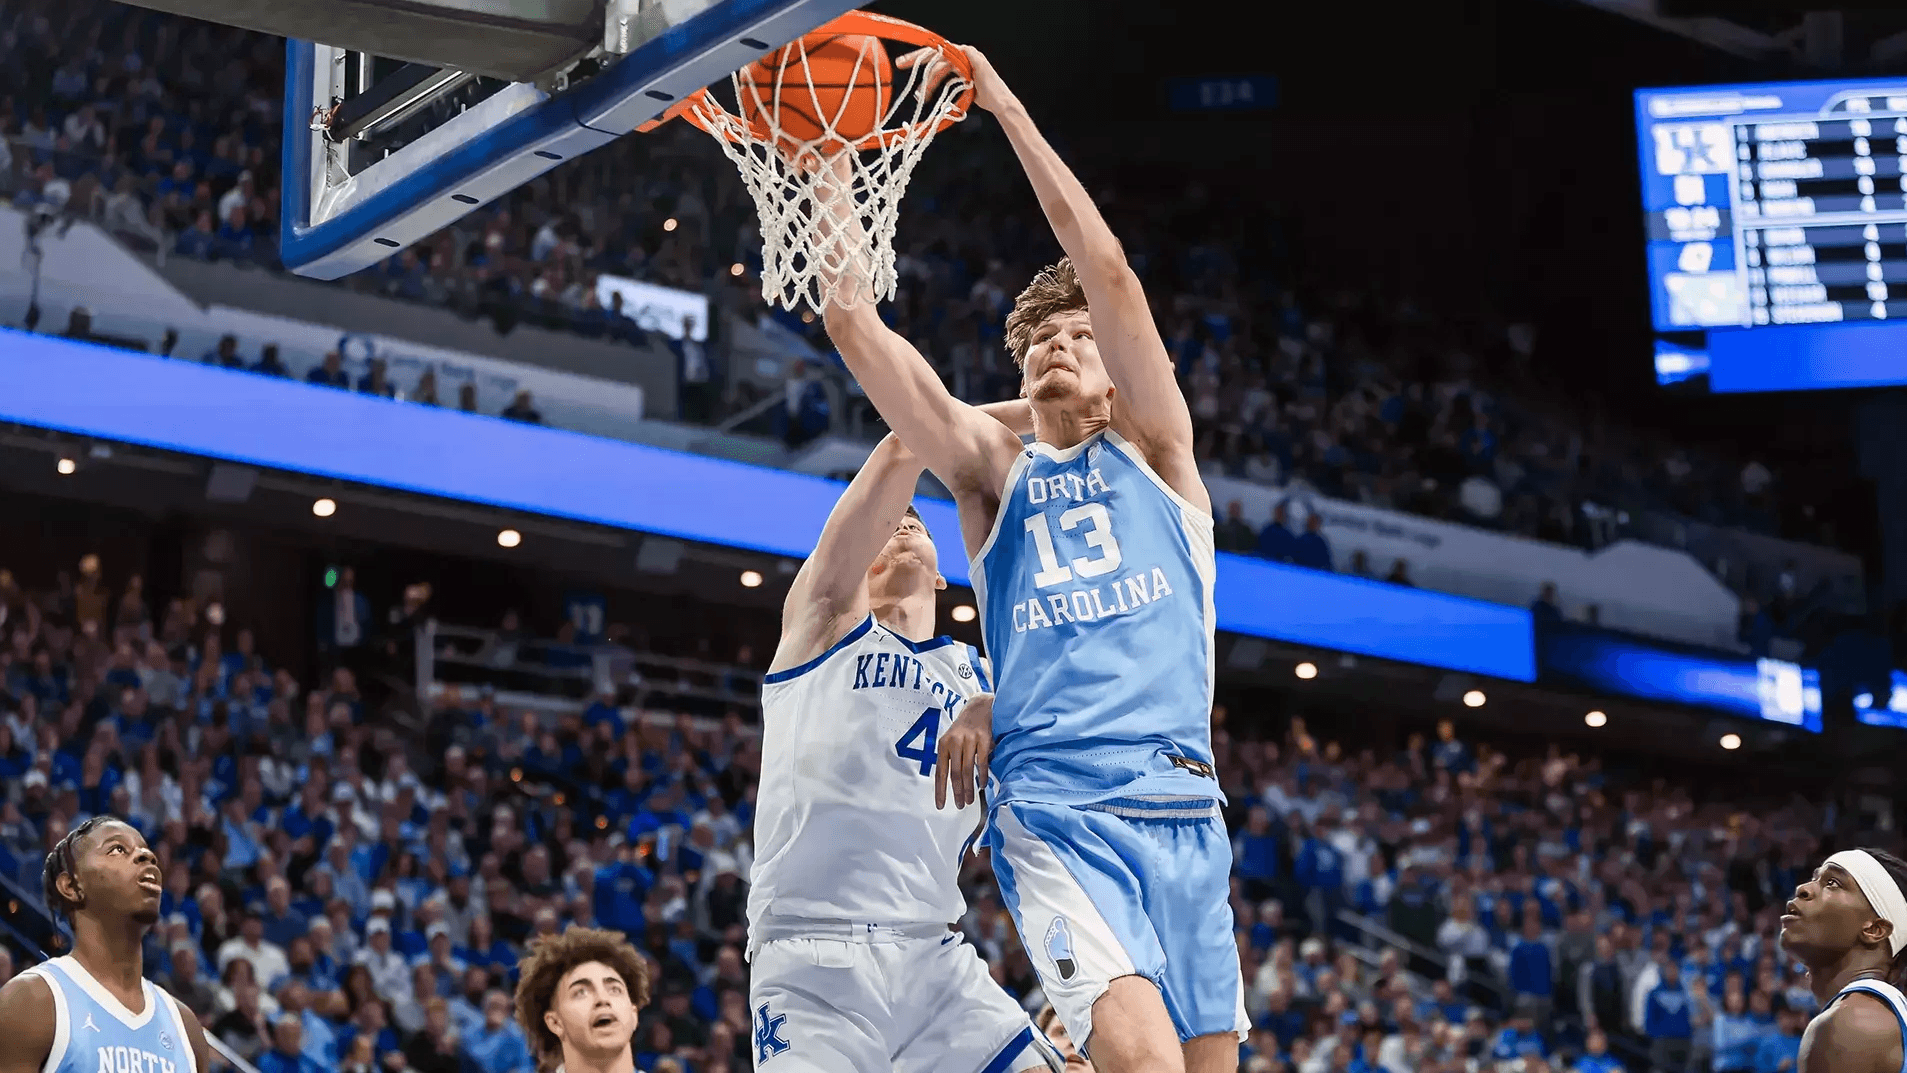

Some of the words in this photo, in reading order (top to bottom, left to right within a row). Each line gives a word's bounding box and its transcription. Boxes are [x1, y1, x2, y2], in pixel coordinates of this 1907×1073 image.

[1024, 502, 1122, 588] 13
[1013, 567, 1172, 633] CAROLINA
[895, 707, 941, 777] 4
